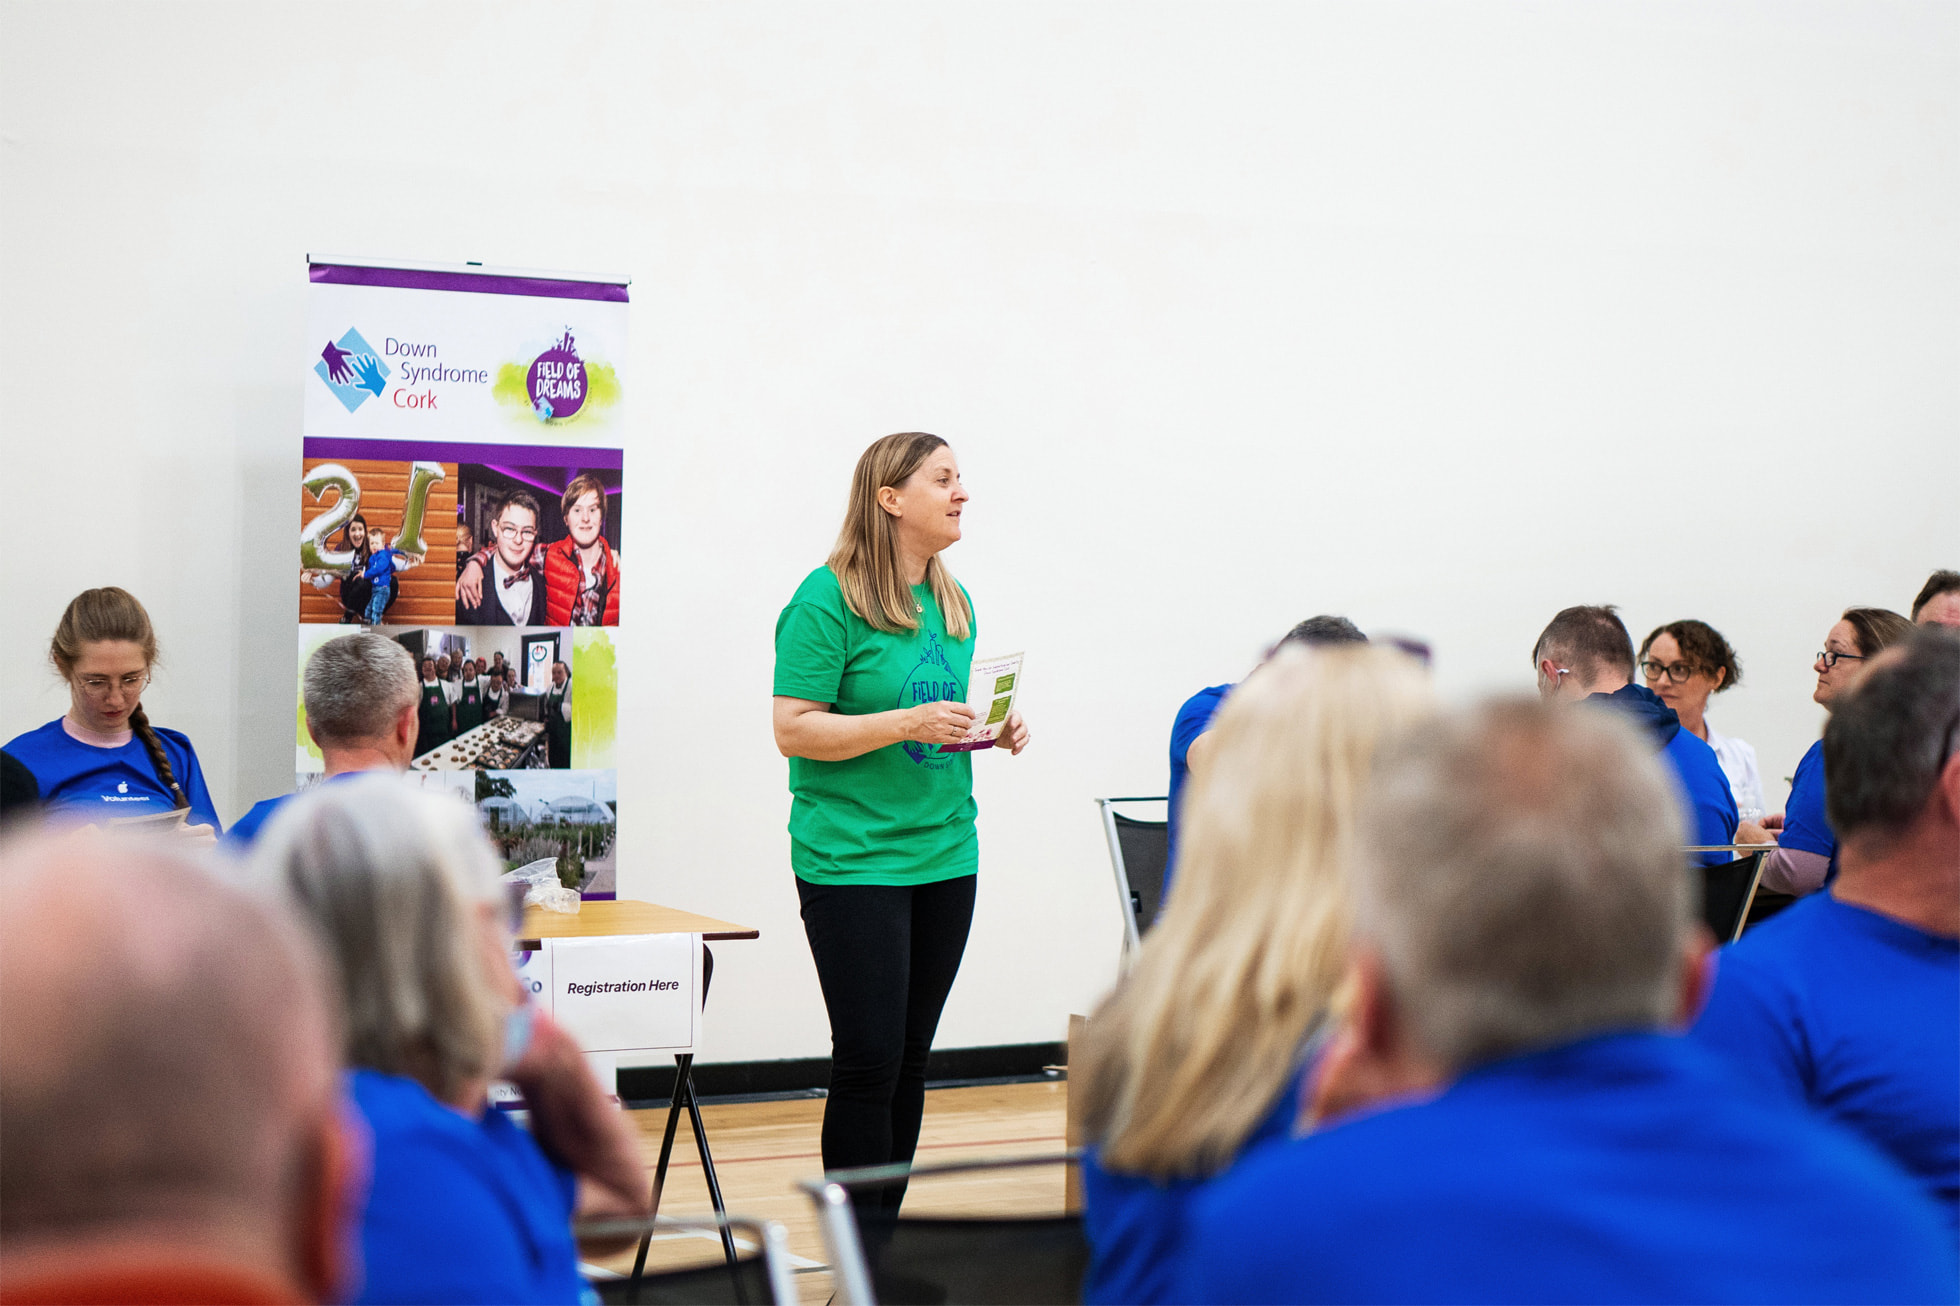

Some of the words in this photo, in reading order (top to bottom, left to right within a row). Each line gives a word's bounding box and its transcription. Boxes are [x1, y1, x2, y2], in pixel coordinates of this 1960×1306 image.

[385, 338, 437, 358] Down
[401, 361, 488, 385] Syndrome
[566, 362, 581, 380] OF
[393, 388, 438, 410] Cork
[536, 379, 581, 401] DREAMS
[942, 681, 957, 702] OF
[924, 761, 945, 770] DOWN
[567, 980, 646, 996] Registration
[649, 979, 679, 992] Here
